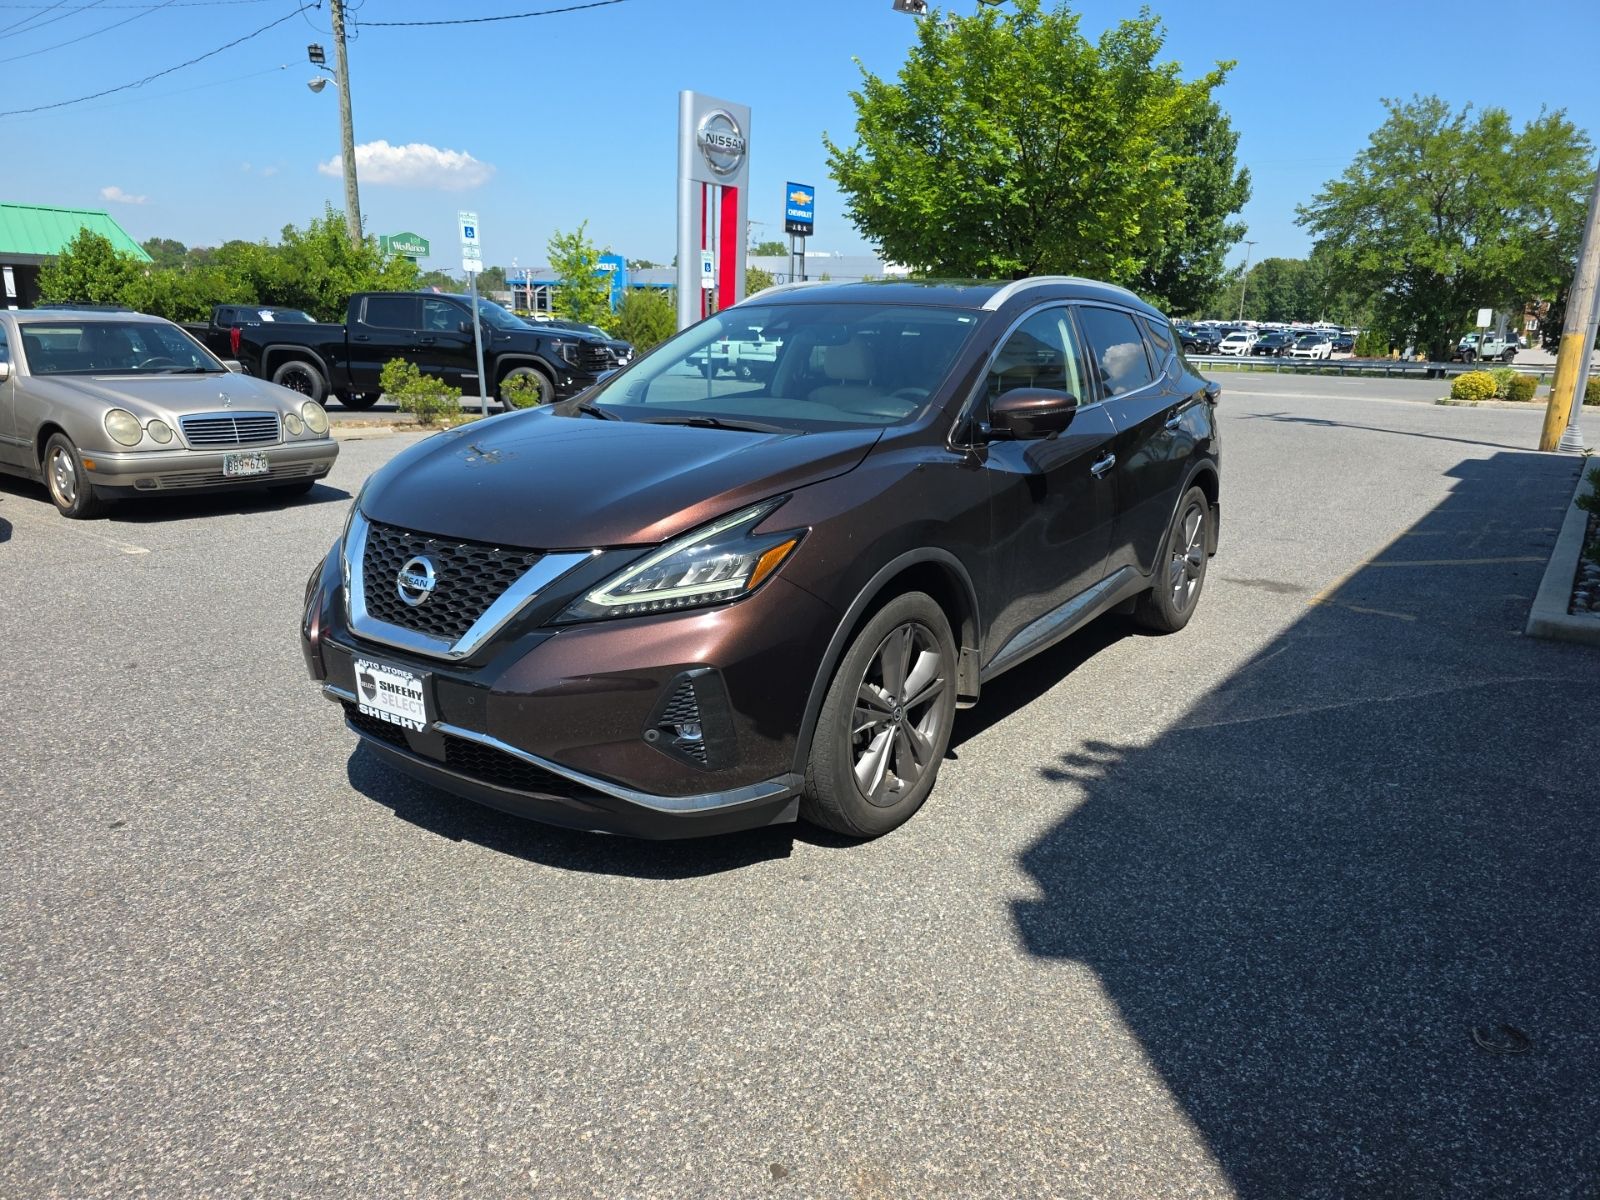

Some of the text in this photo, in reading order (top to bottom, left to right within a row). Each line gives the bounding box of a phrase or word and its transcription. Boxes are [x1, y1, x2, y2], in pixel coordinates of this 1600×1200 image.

[705, 133, 744, 151] NISSAN
[358, 659, 413, 680] AUTO STORES
[379, 681, 422, 701] SHEEHY
[381, 692, 424, 715] SELECT
[358, 703, 426, 732] SHEEHY
